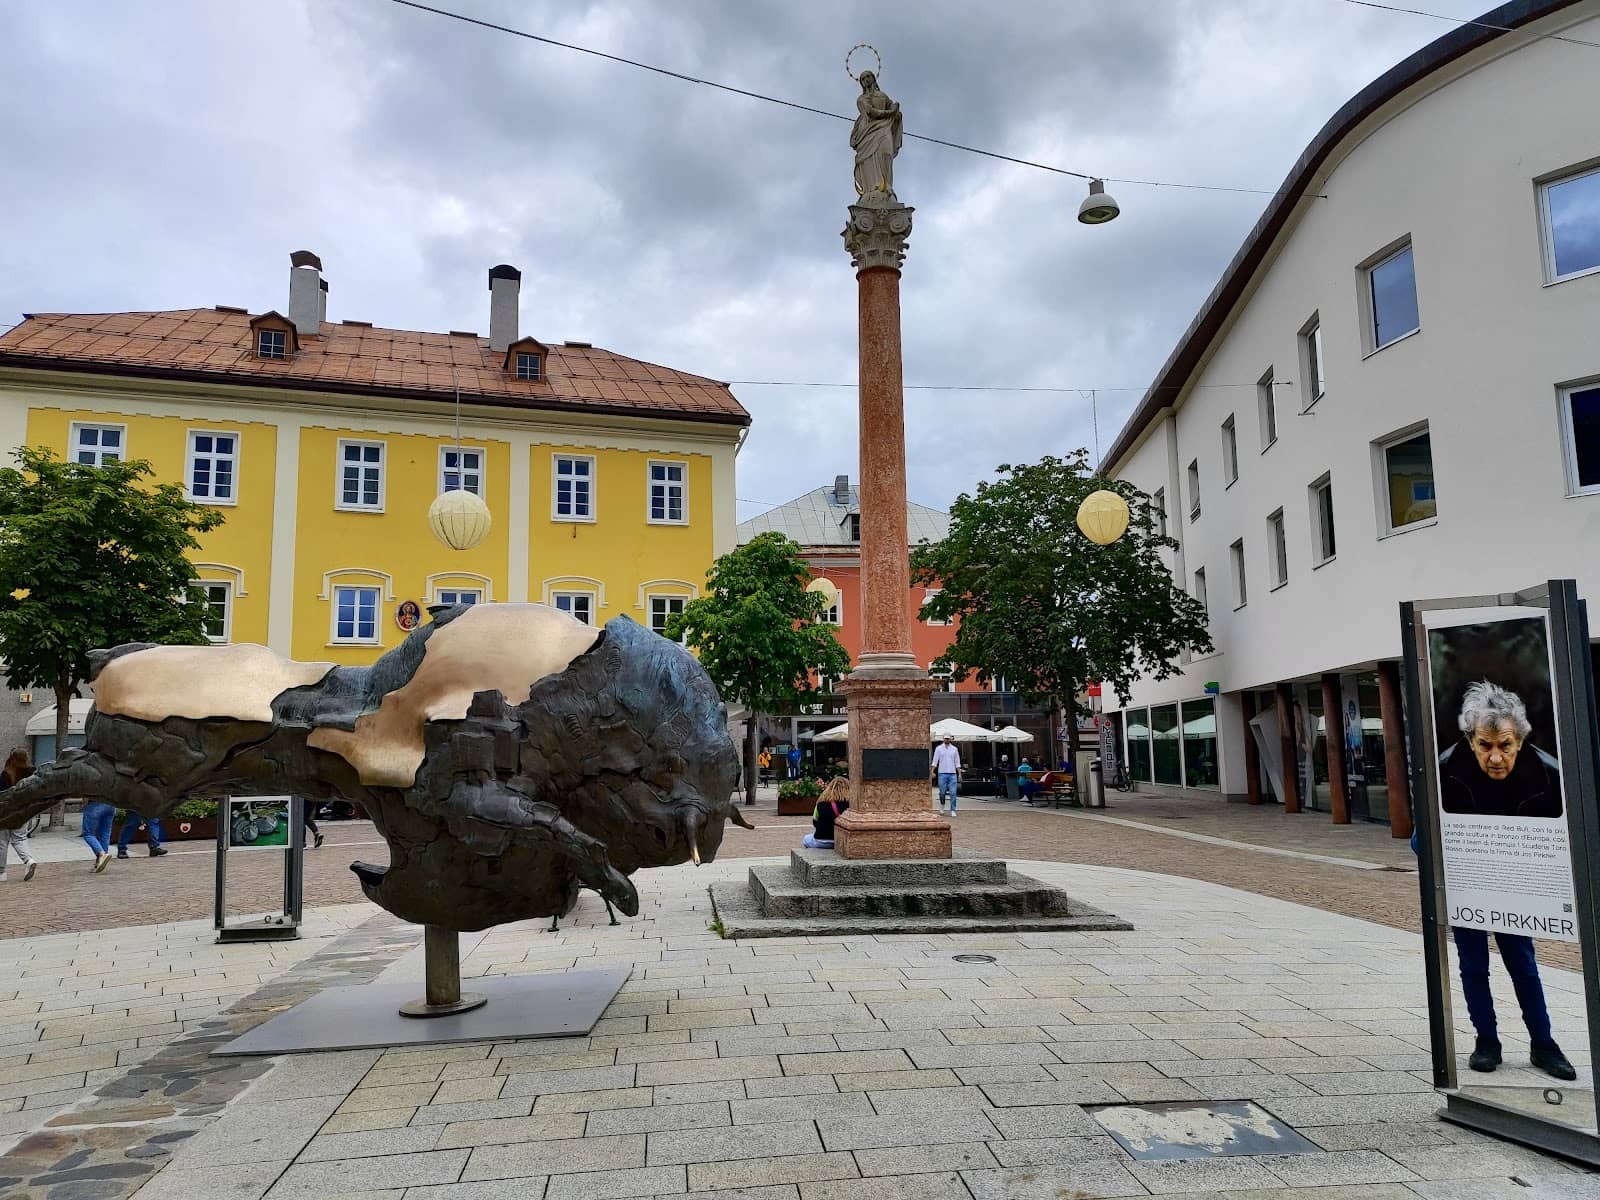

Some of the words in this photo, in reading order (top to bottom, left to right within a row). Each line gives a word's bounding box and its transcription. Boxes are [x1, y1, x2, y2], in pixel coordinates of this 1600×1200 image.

[1490, 840, 1515, 848] Formula
[1522, 843, 1550, 851] Scuderia
[1451, 906, 1485, 924] JOS
[1491, 910, 1574, 936] PIRKNER
